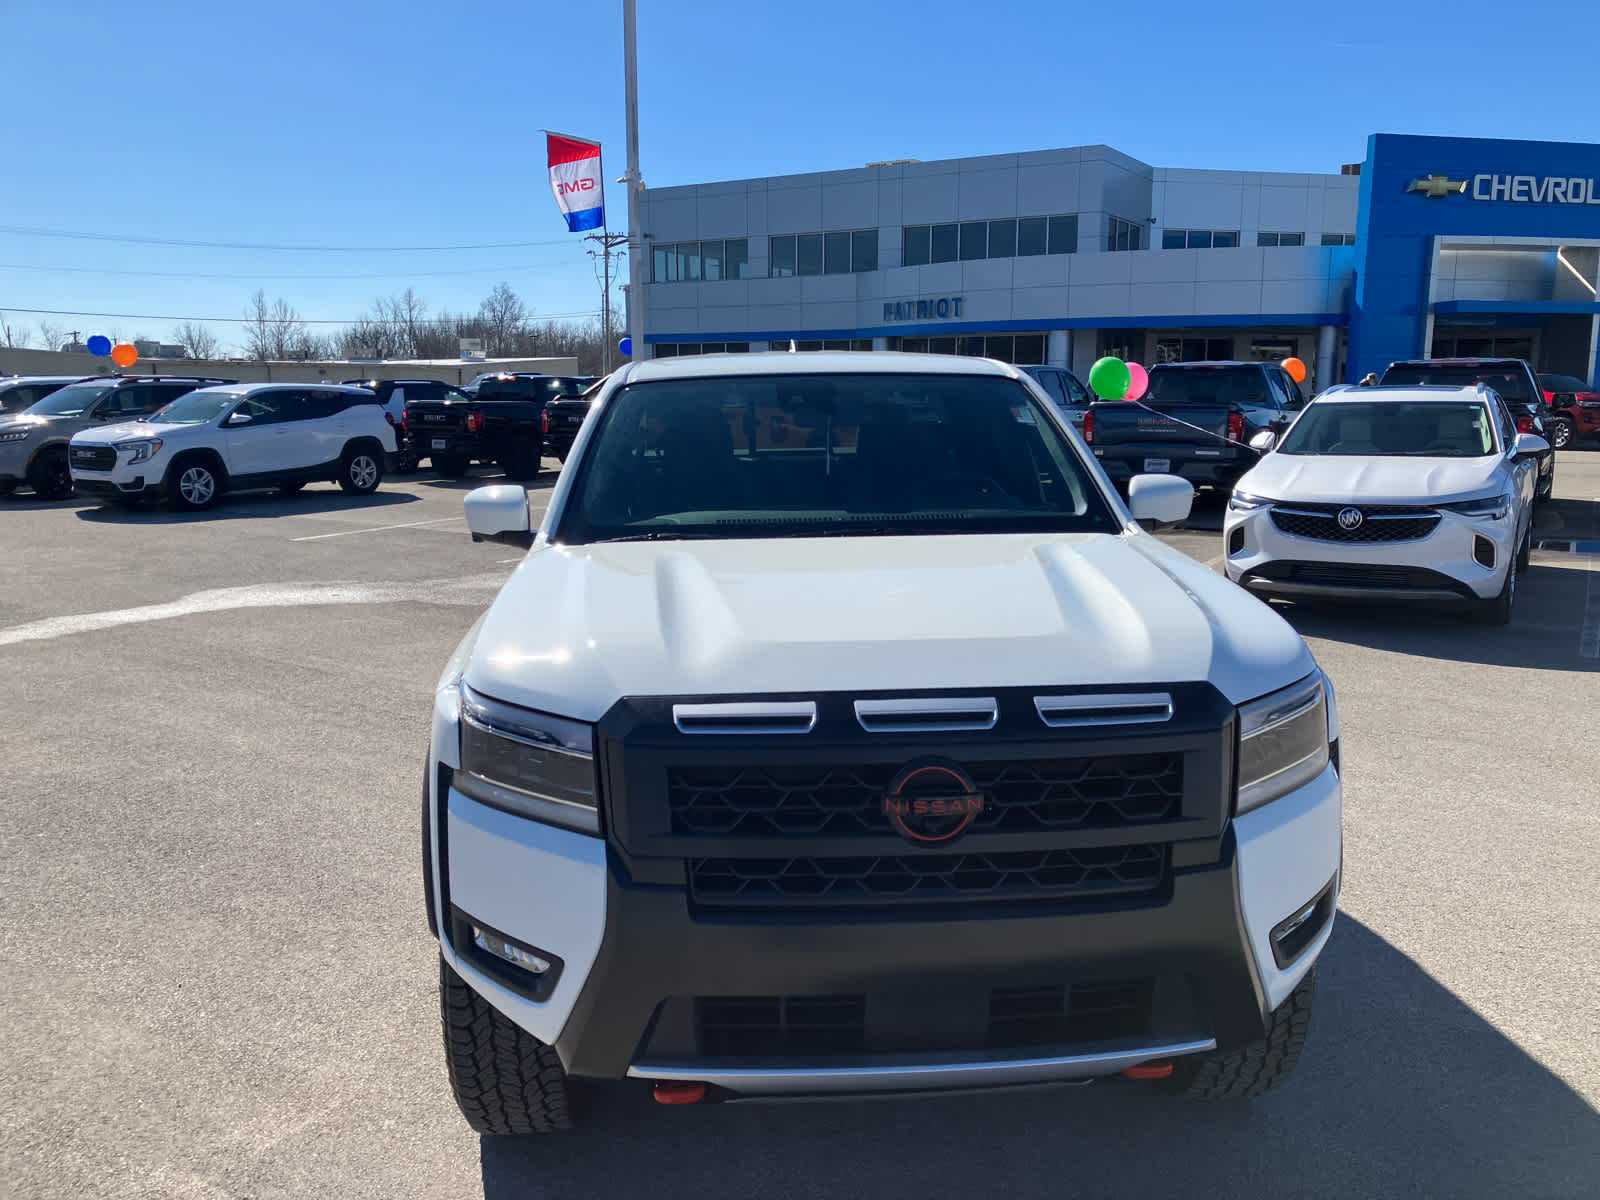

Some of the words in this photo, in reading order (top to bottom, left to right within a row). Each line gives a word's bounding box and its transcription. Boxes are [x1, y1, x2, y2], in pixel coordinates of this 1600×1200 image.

[1473, 174, 1600, 204] CHEVROL
[883, 297, 963, 321] PATRIOT
[885, 797, 981, 814] NISSAN
